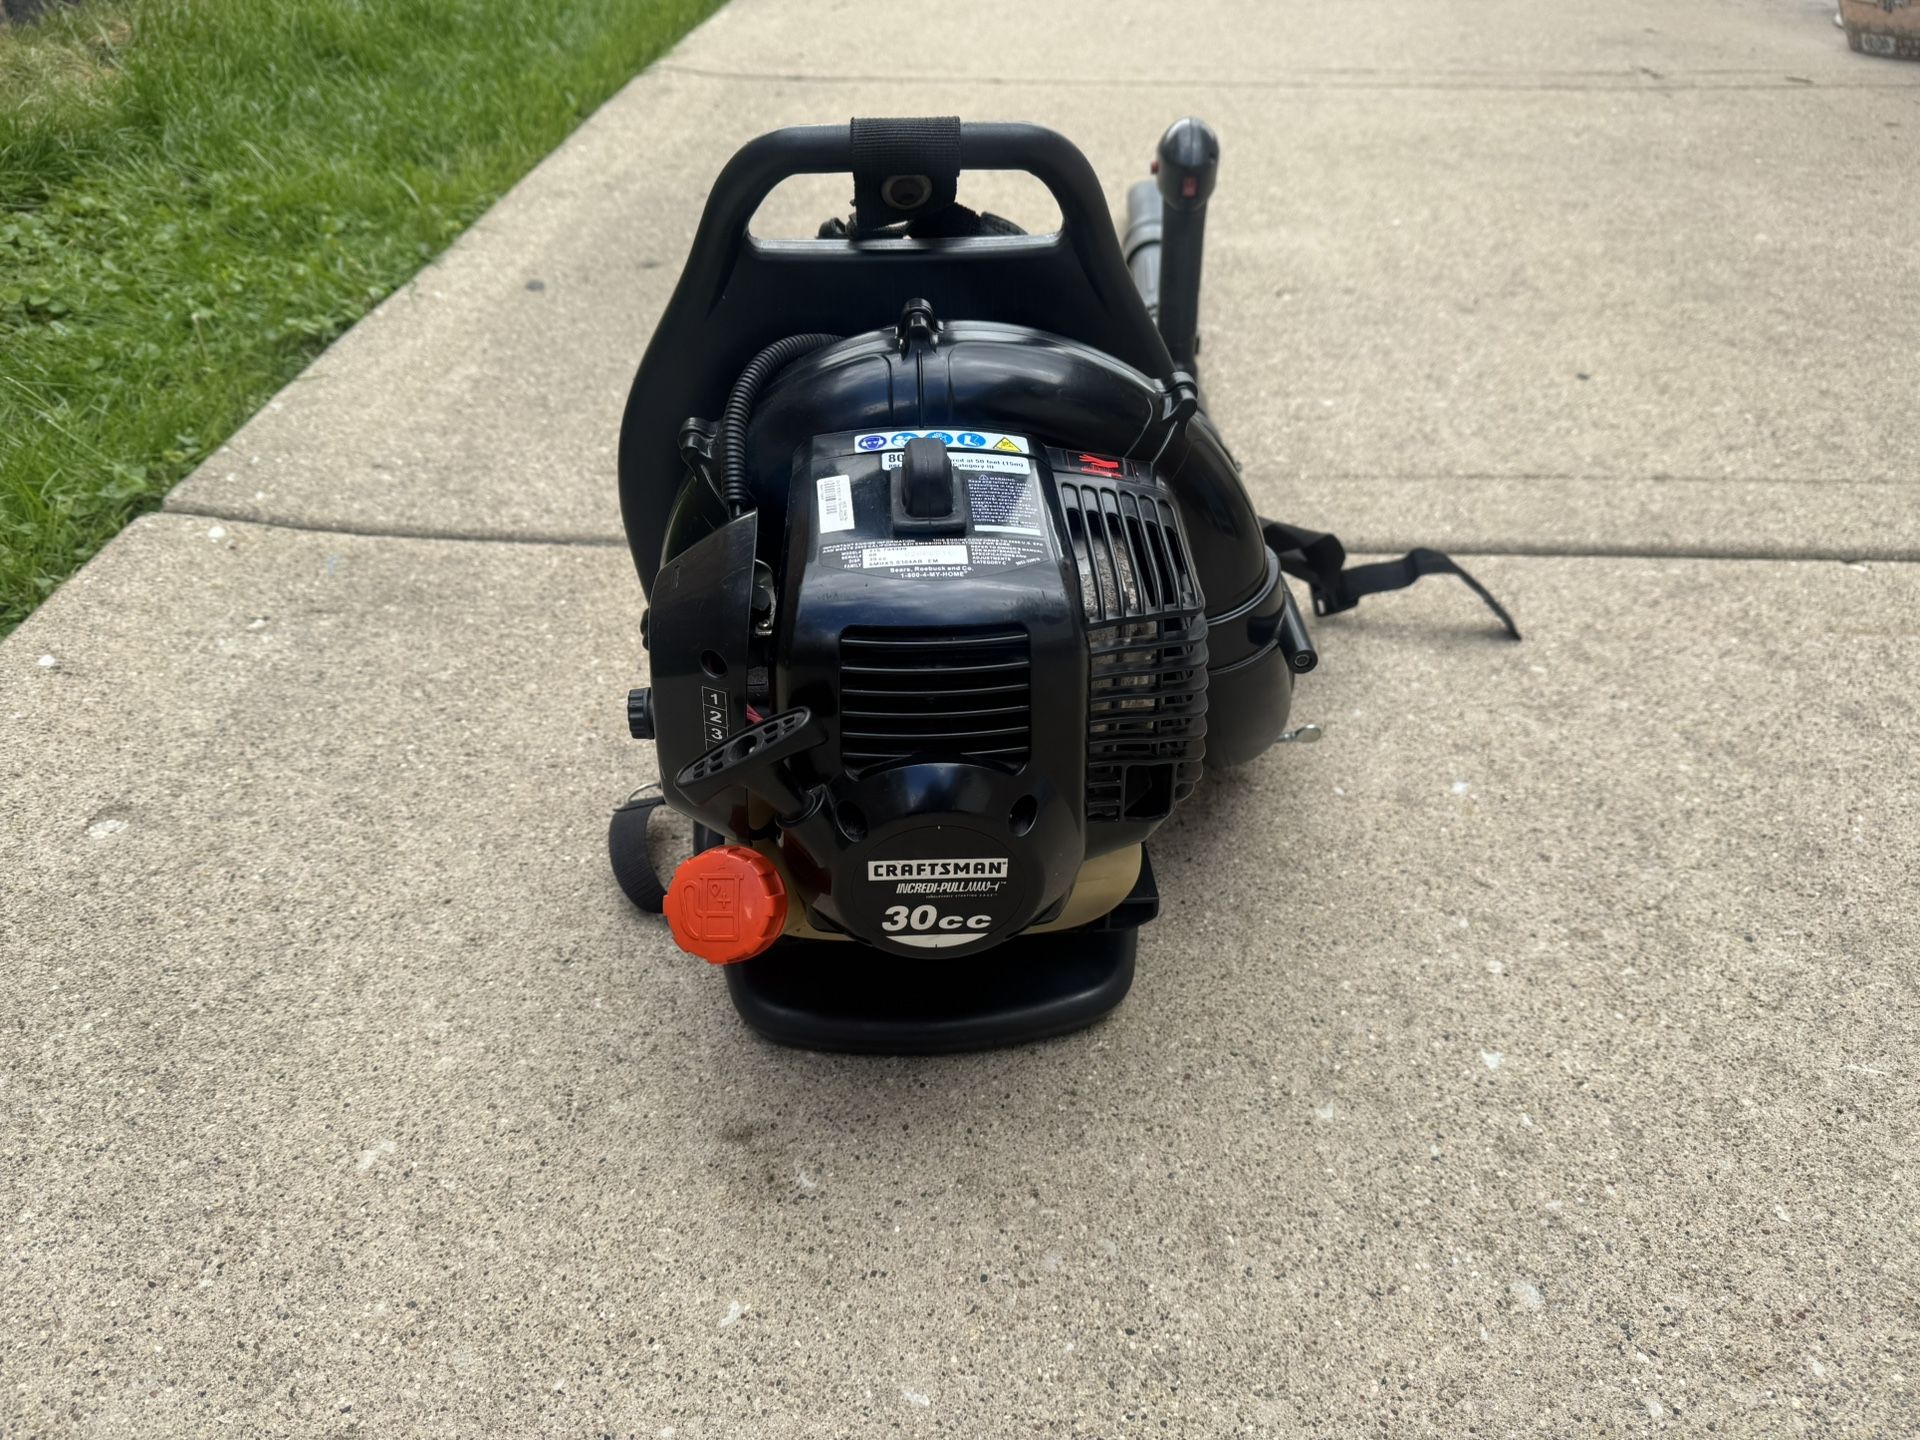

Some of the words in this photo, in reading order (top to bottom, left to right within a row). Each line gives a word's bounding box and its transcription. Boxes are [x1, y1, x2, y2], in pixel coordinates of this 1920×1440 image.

[710, 693, 718, 705] 1
[710, 710, 722, 723] 2
[711, 728, 723, 740] 3
[873, 862, 1002, 877] CRAFTSMAN
[882, 904, 992, 931] 30cc
